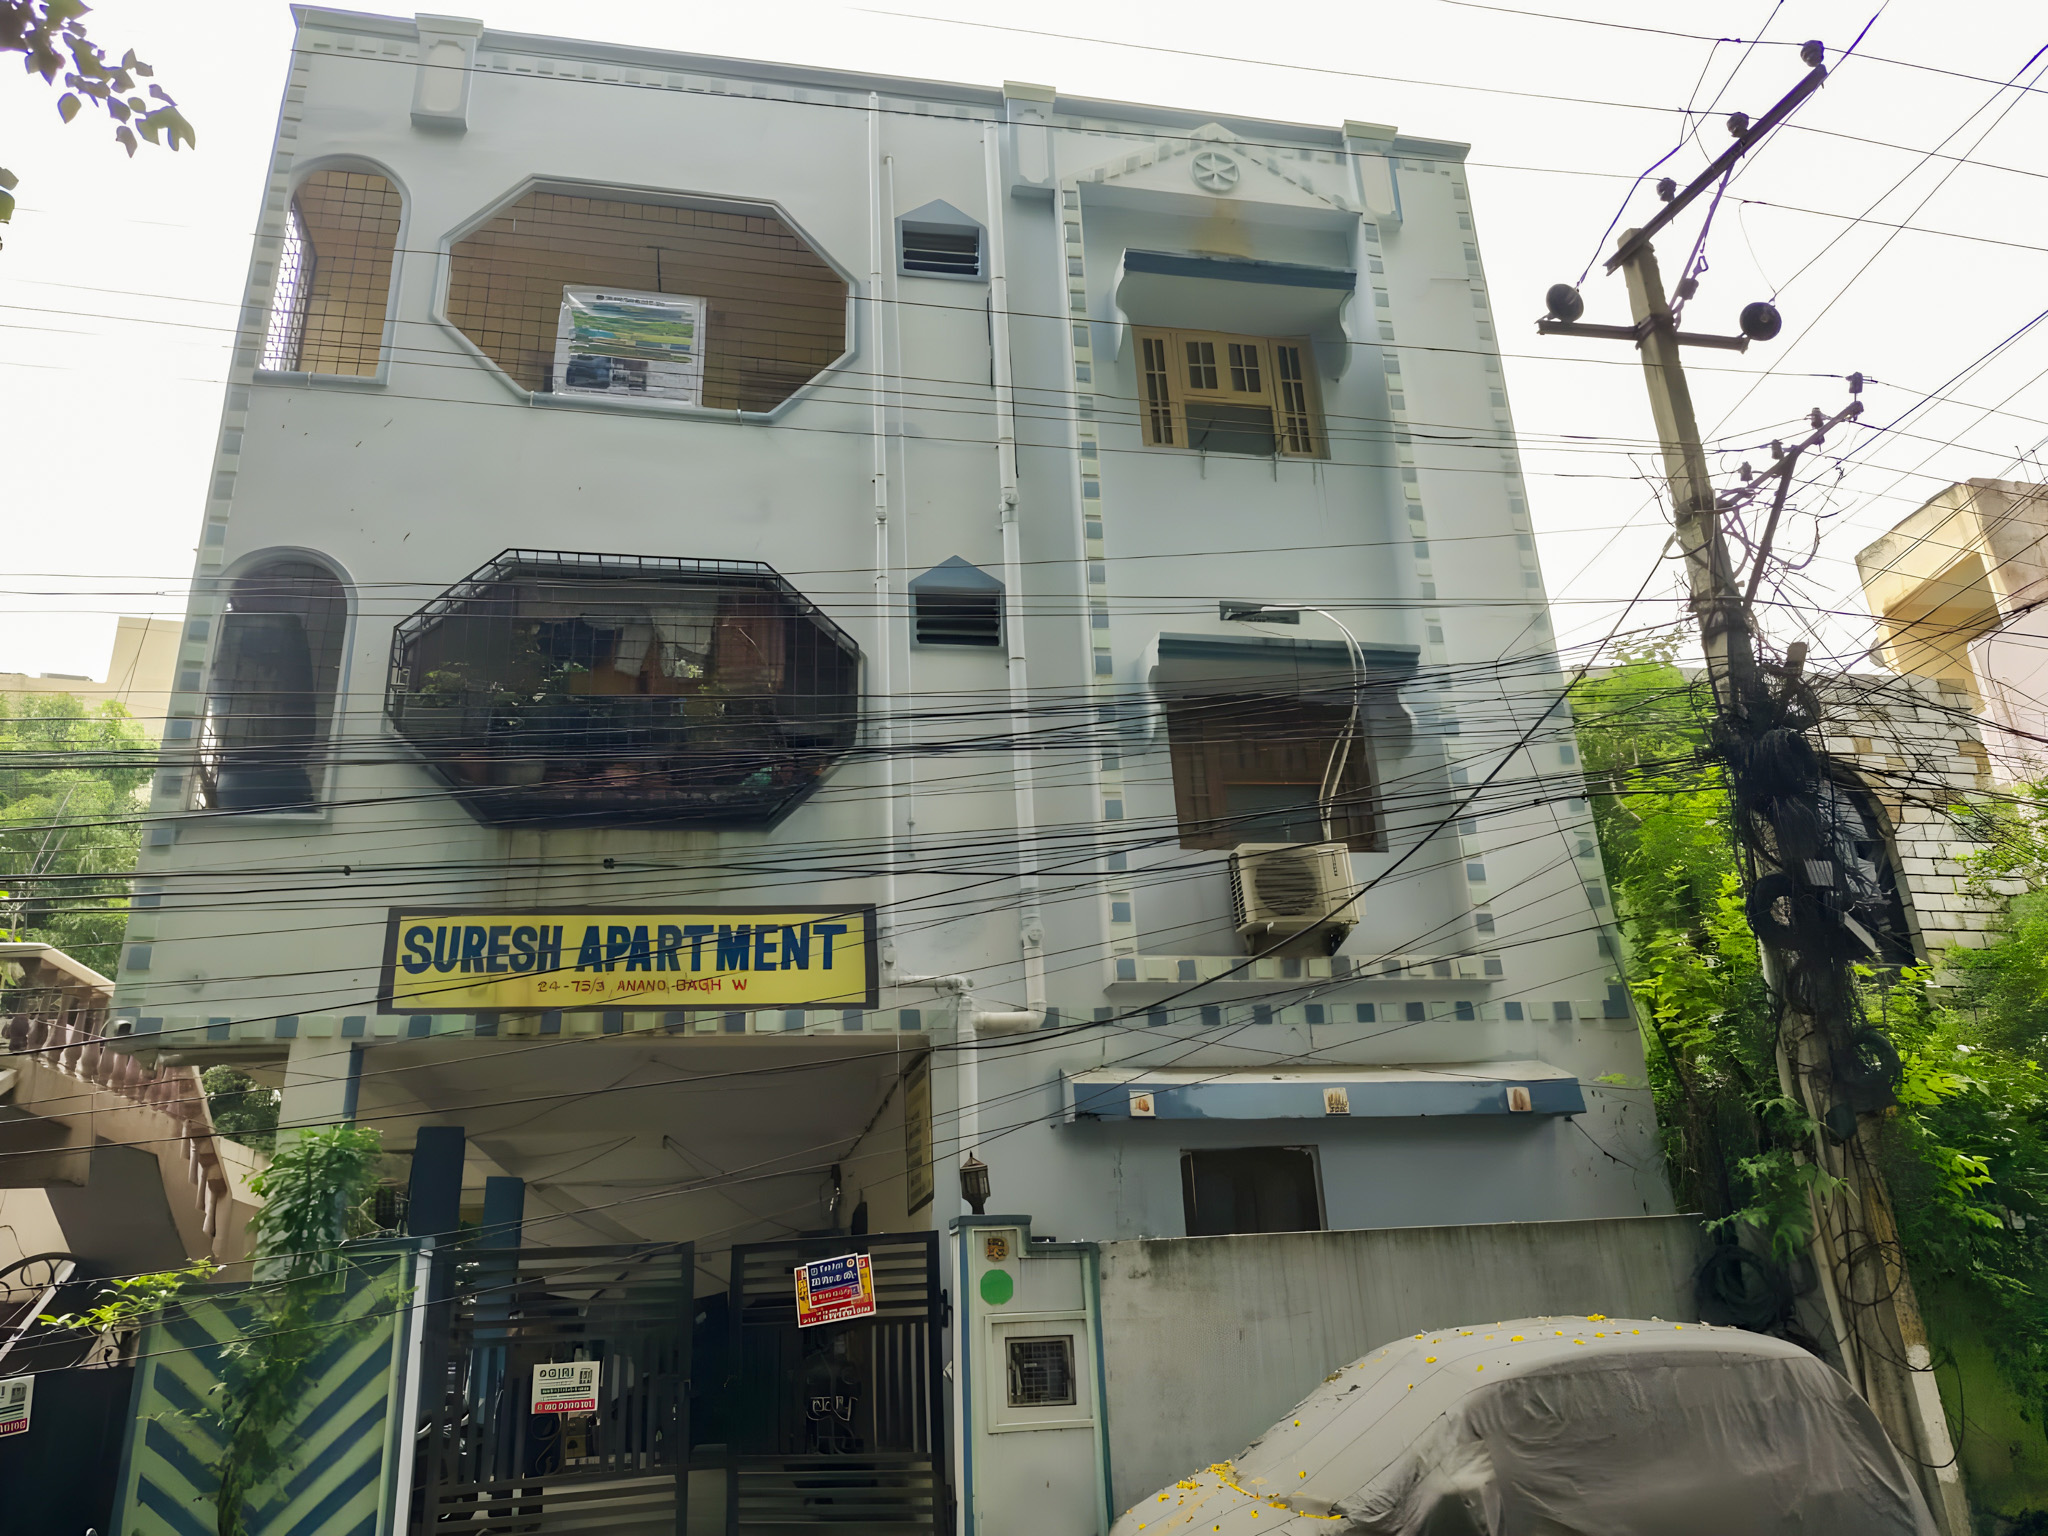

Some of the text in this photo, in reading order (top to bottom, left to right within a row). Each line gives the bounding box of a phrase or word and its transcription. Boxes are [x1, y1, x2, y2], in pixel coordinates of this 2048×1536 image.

[401, 924, 848, 975] SURESH APARTMENT
[732, 978, 748, 991] W
